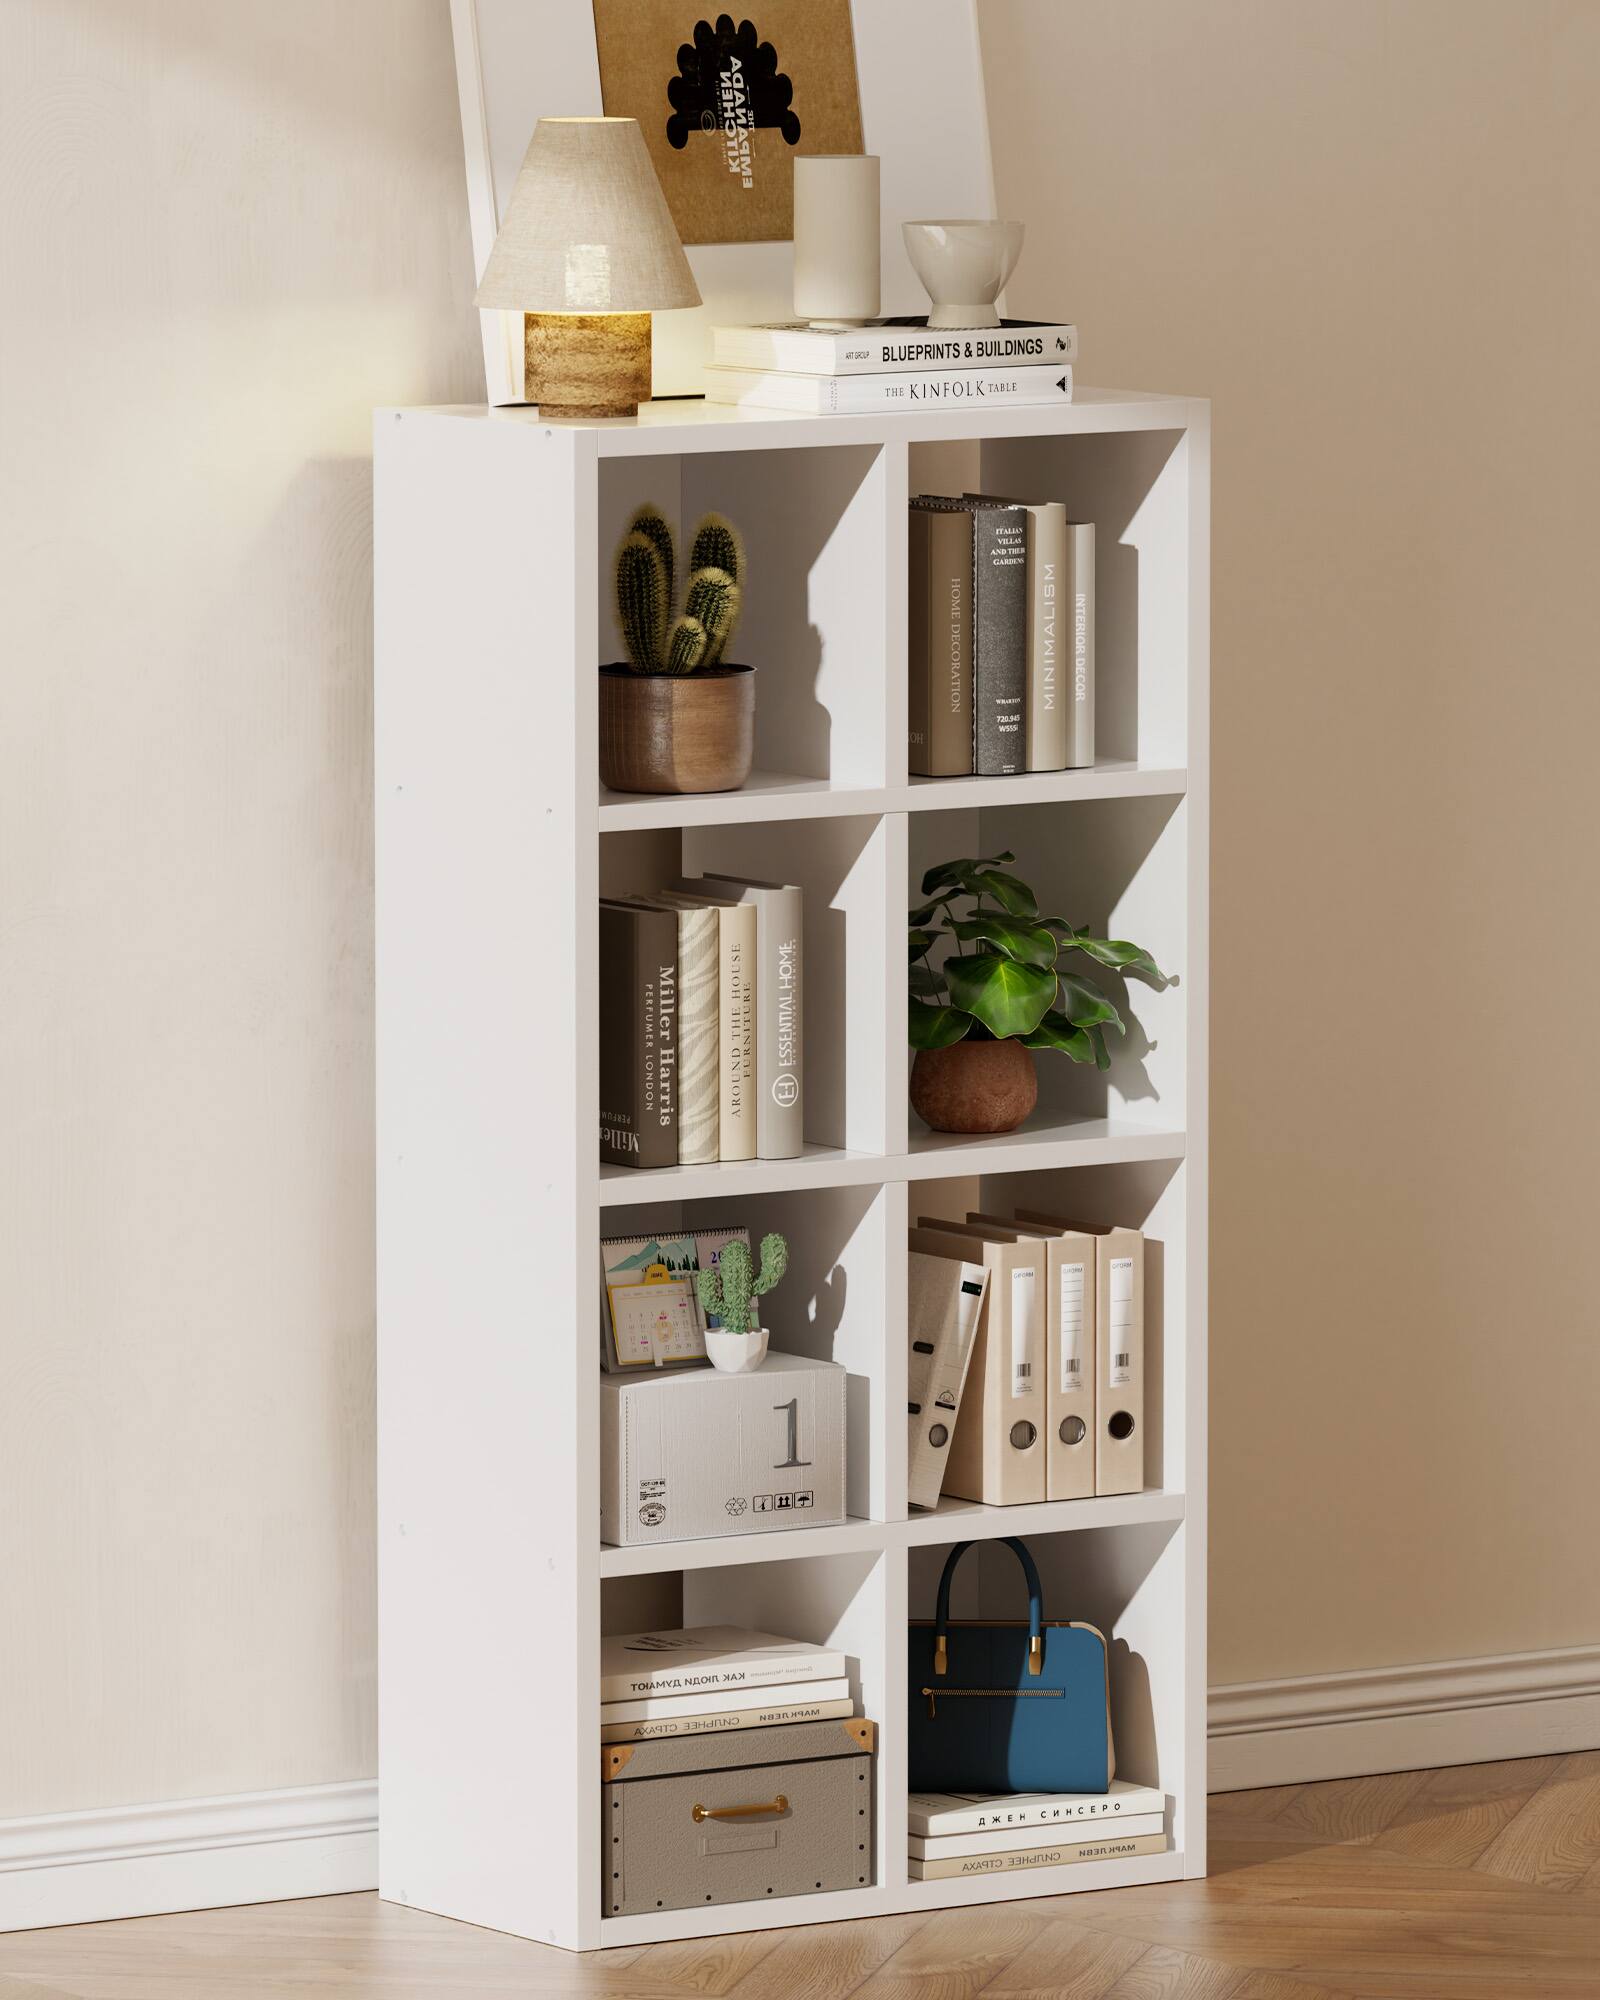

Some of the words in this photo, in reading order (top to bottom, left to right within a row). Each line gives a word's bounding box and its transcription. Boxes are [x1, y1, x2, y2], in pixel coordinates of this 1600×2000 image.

[882, 343, 960, 362] BLUEPRINTS
[964, 343, 973, 358] &
[976, 338, 1043, 357] BUILDINGS
[885, 386, 905, 397] THE
[909, 380, 986, 400] KINFOLK
[987, 382, 1017, 394] TABLE
[996, 527, 1023, 535] ITALIAN
[998, 537, 1022, 545] VILLAS
[993, 557, 1025, 566] GARDENS
[951, 577, 960, 619] HOME
[1076, 593, 1086, 653] INTERIOR
[1044, 563, 1055, 710] MINIMALISM
[951, 624, 960, 713] DECORATION
[1076, 654, 1086, 702] DECOR
[996, 714, 1021, 723] 720.945
[731, 943, 741, 999] HOUSE
[779, 940, 793, 989] HOME
[645, 983, 653, 1048] PERFUMER
[659, 966, 675, 1040] Miller
[731, 1006, 741, 1041] THE
[743, 982, 751, 1078] FURNITURE
[779, 992, 793, 1067] ESSENTIAL
[645, 1055, 653, 1112] LONDON
[659, 1047, 675, 1127] Harris
[731, 1047, 741, 1118] AROUND
[773, 1398, 811, 1468] 1
[978, 1812, 1026, 1827] ДЖЕН
[1040, 1803, 1121, 1819] СИНСЕРО
